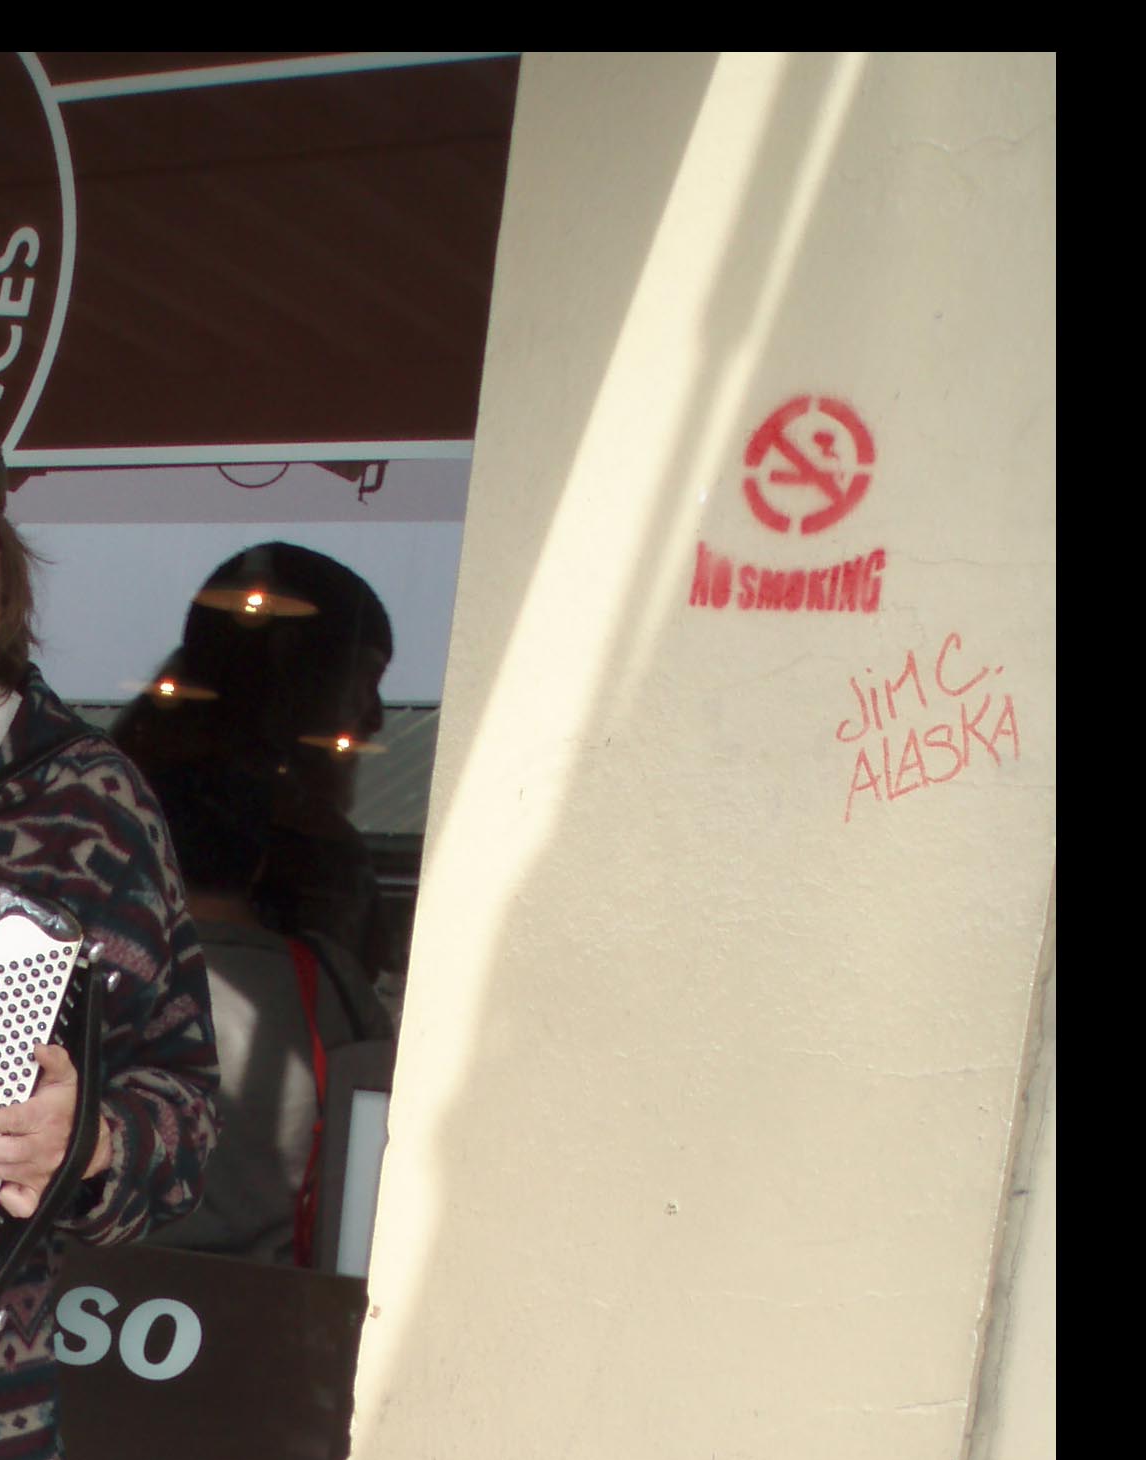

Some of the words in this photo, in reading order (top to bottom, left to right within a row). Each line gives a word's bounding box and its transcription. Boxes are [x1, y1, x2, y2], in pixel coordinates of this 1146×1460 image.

[689, 541, 733, 609] NO
[737, 548, 886, 613] SMOKING
[844, 693, 1020, 823] ALASKA
